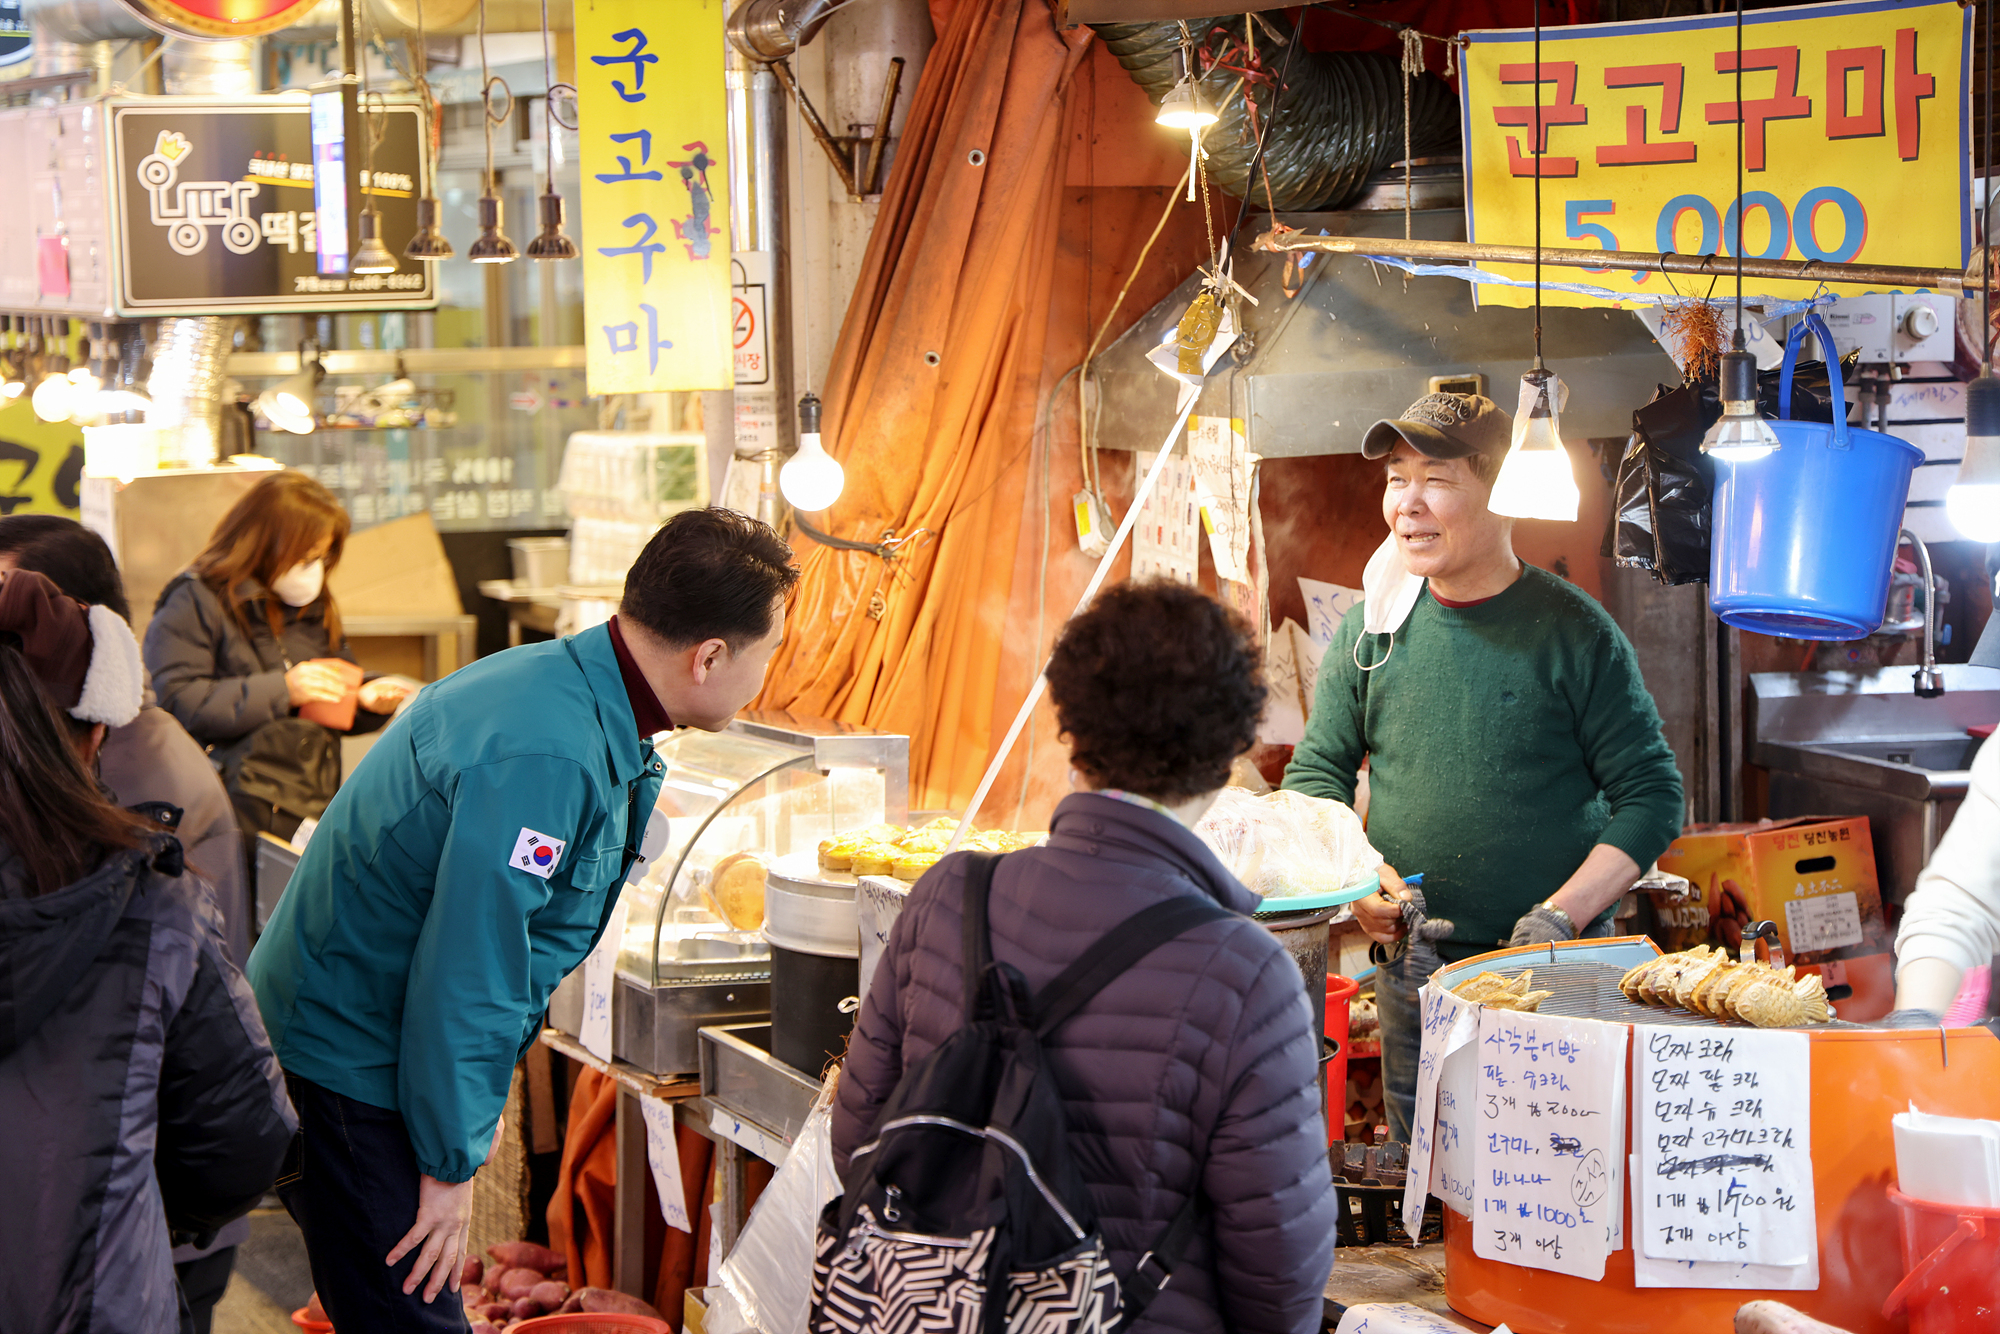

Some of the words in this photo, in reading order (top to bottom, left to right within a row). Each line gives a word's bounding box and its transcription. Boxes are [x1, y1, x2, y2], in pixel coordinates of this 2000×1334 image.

[1493, 27, 1936, 180] 군고구마
[591, 28, 673, 375] 군고구마
[1565, 186, 1868, 285] 5,000
[1804, 827, 1851, 846] 당진농원
[1485, 1026, 1580, 1063] 사각붕어빵
[1484, 1094, 1515, 1119] 3개
[1493, 1169, 1551, 1186] 바나나
[1484, 1198, 1507, 1214] 1개
[1657, 1193, 1686, 1208] 1개
[1494, 1229, 1521, 1251] 3개
[1536, 1234, 1563, 1259] 이상
[1708, 1222, 1749, 1249] 이상
